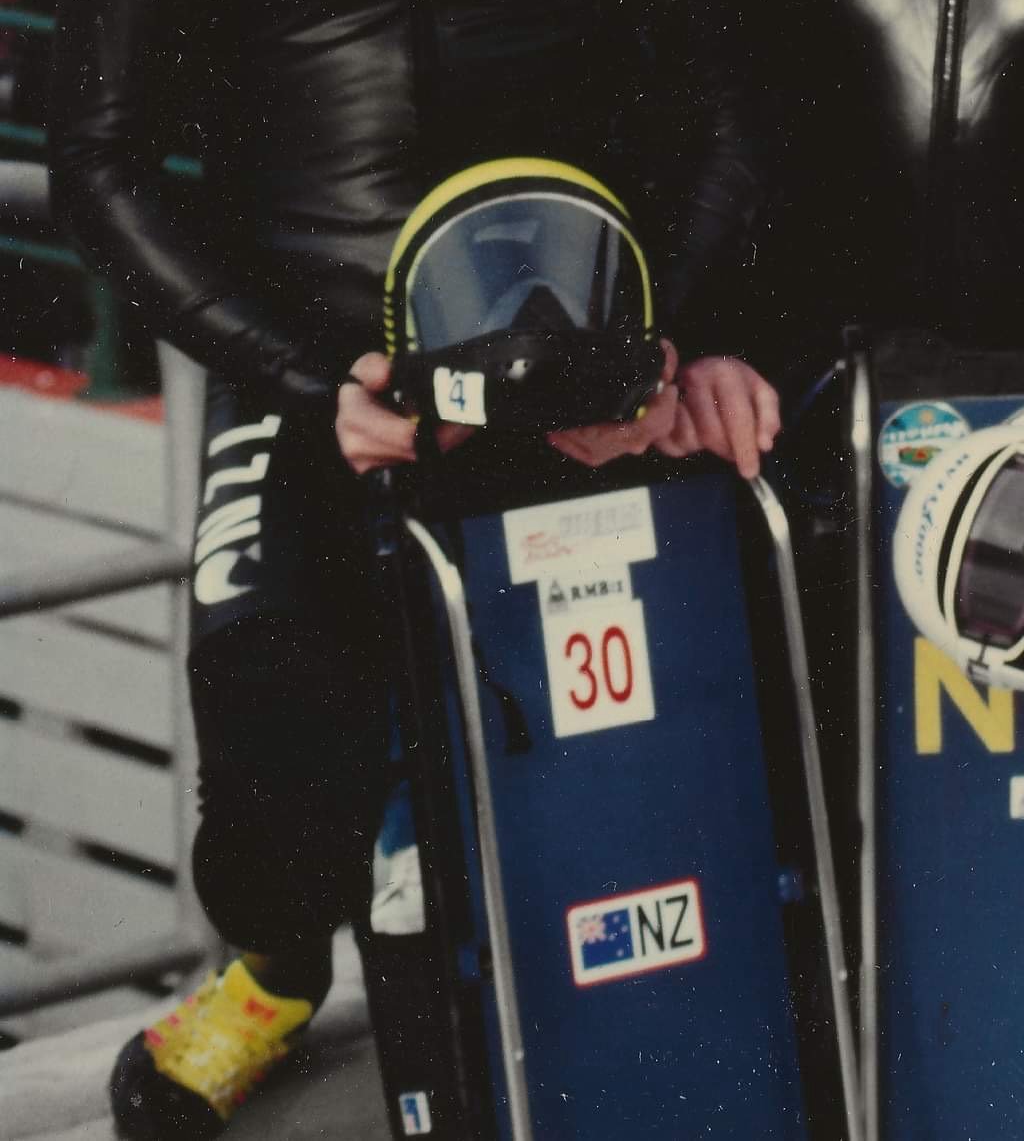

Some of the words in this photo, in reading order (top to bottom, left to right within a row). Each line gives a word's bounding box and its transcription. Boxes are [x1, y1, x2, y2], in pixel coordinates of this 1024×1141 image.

[449, 379, 465, 412] 4
[565, 626, 633, 710] 30
[637, 894, 693, 956] NZ
